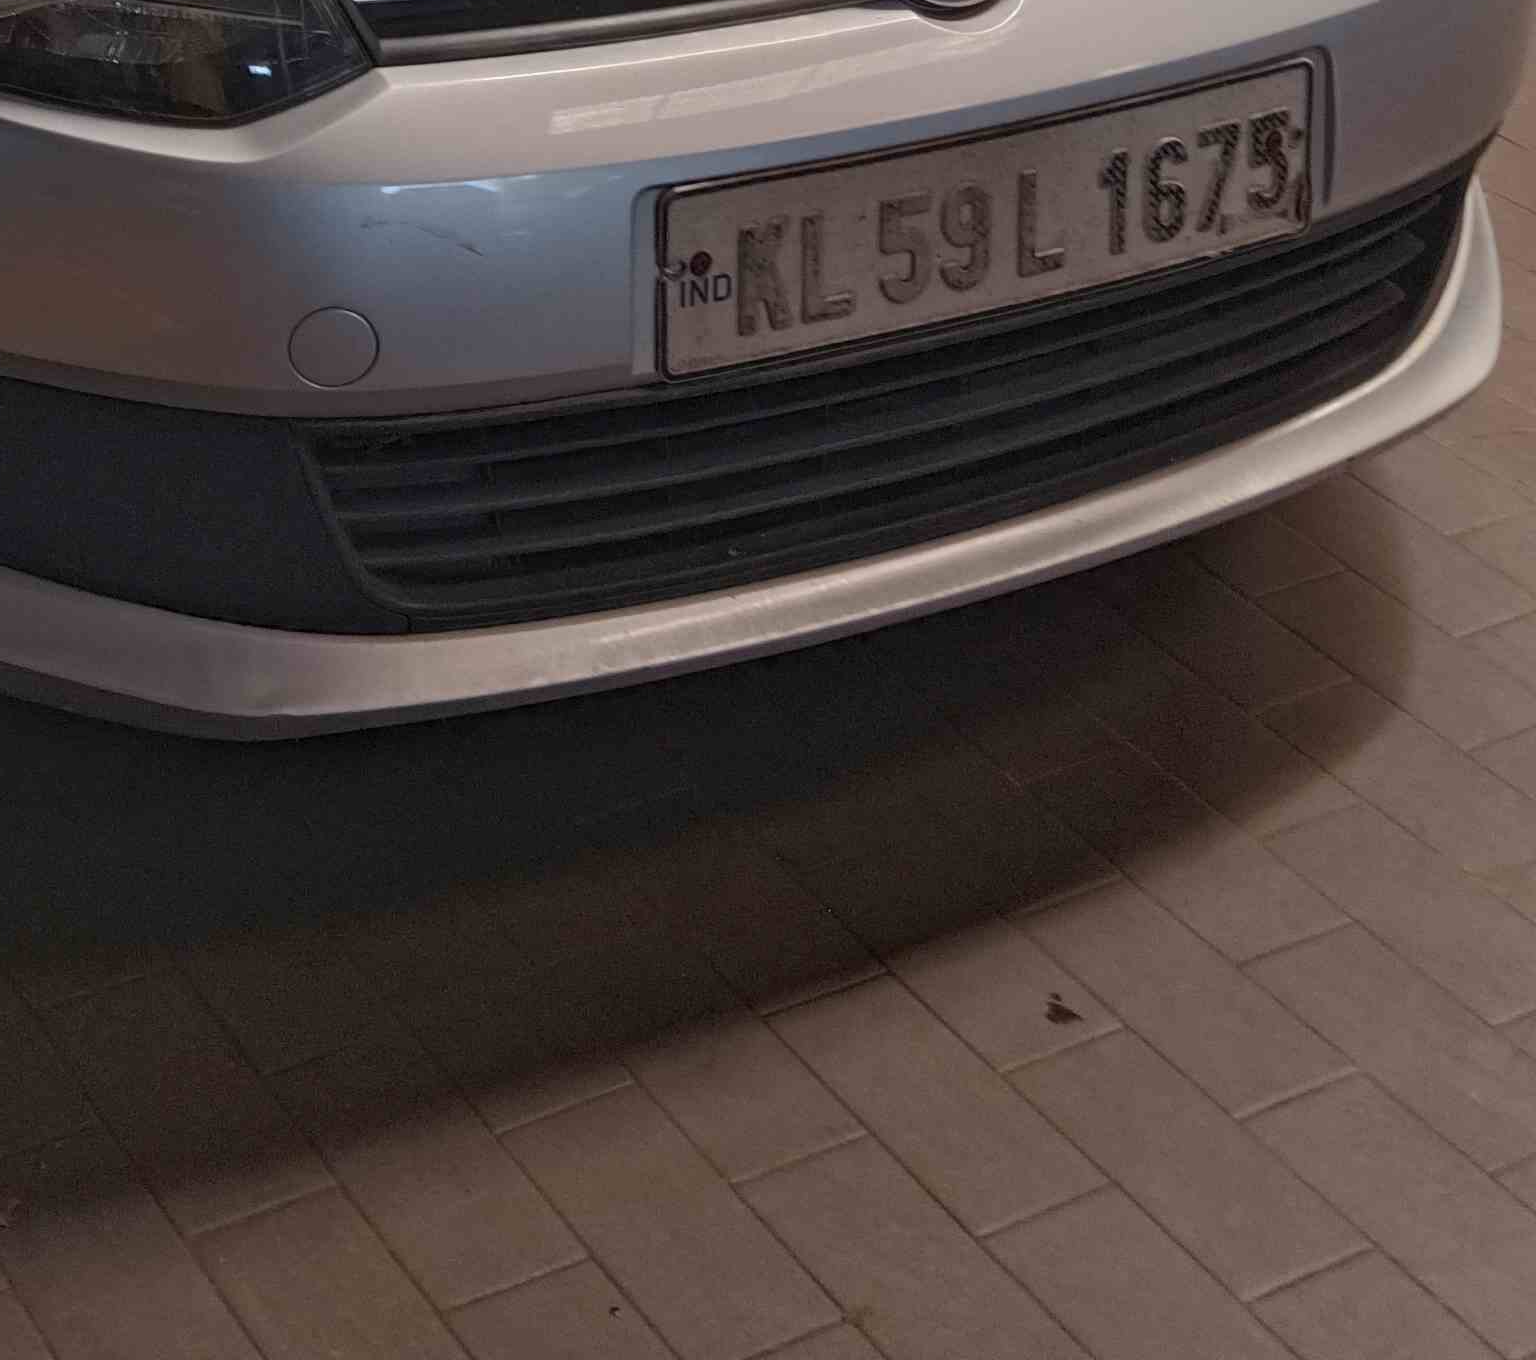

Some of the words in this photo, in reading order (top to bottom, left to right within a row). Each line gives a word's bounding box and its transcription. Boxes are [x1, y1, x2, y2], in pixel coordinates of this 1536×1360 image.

[737, 210, 857, 338] KL
[877, 185, 993, 305] 59
[1016, 168, 1065, 279] L
[1097, 107, 1290, 256] 1675
[679, 273, 733, 309] IND
